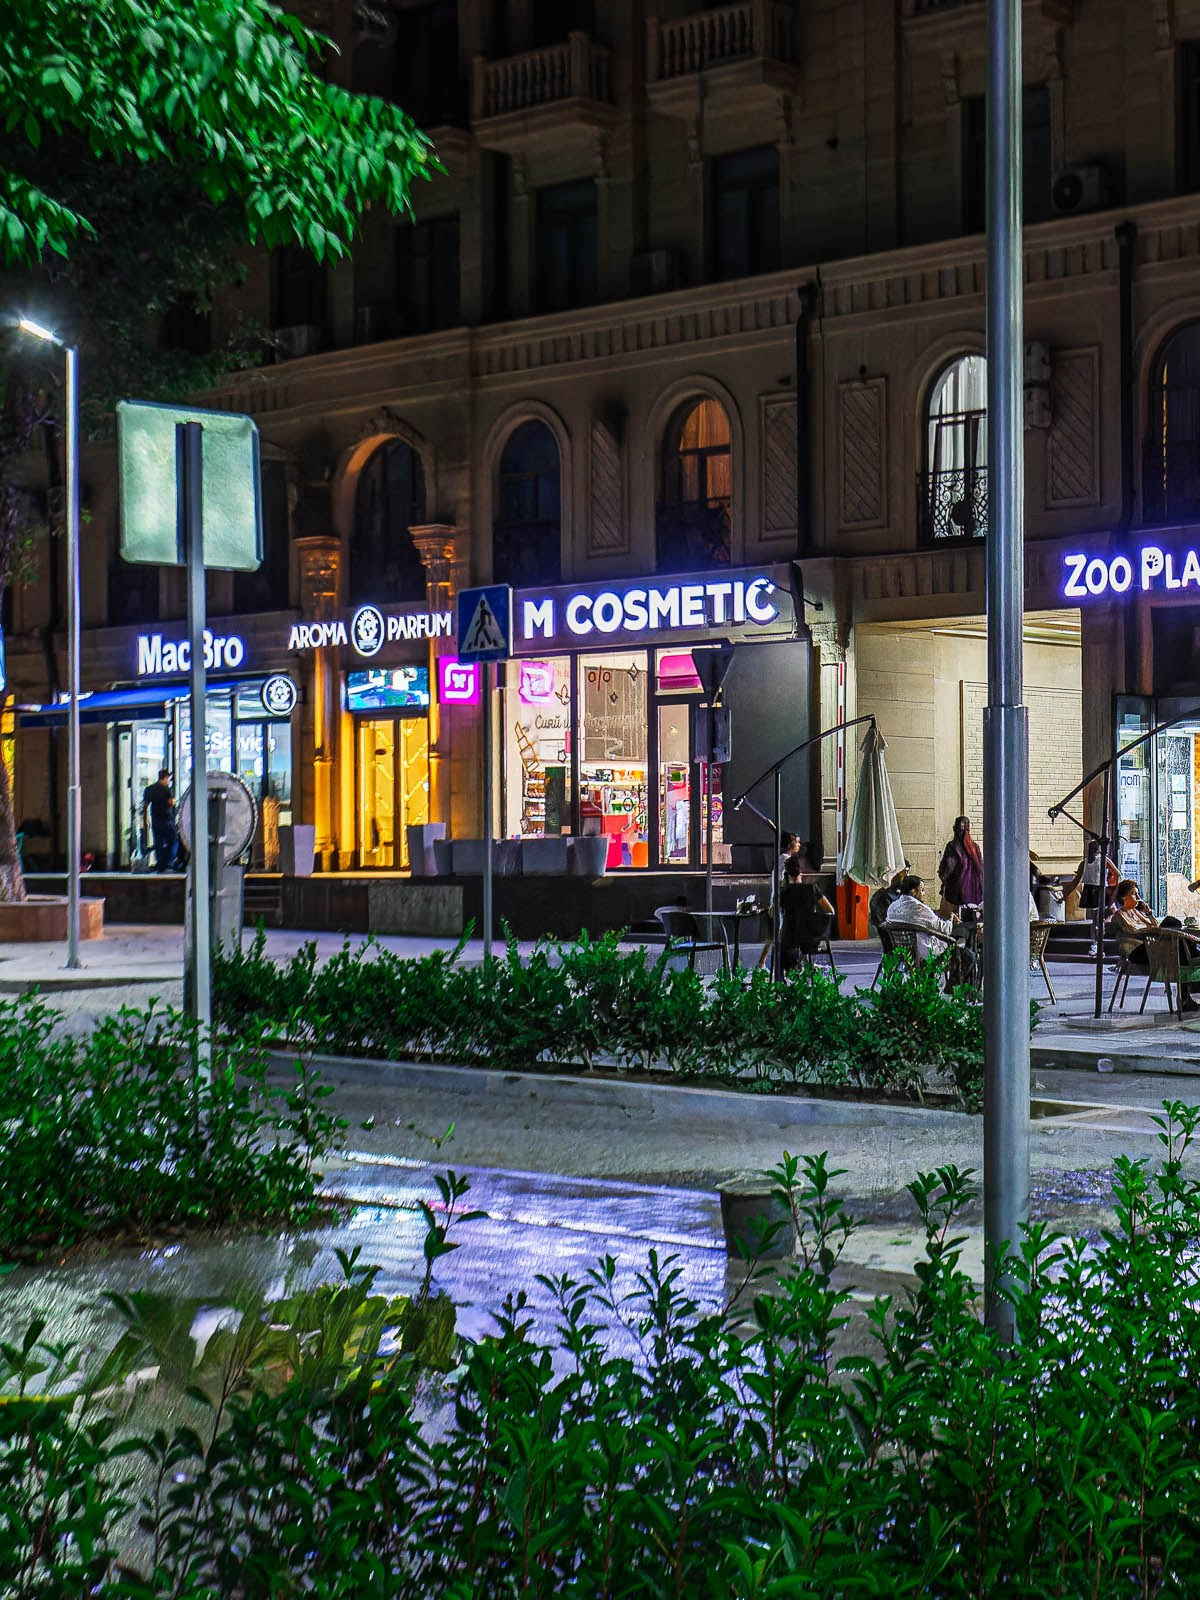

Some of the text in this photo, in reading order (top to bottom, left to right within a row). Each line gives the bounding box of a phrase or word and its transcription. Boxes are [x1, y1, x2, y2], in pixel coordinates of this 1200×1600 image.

[288, 611, 453, 650] AROMA PARFUM
[523, 577, 778, 639] M COSMETIC
[137, 629, 244, 675] MacBro
